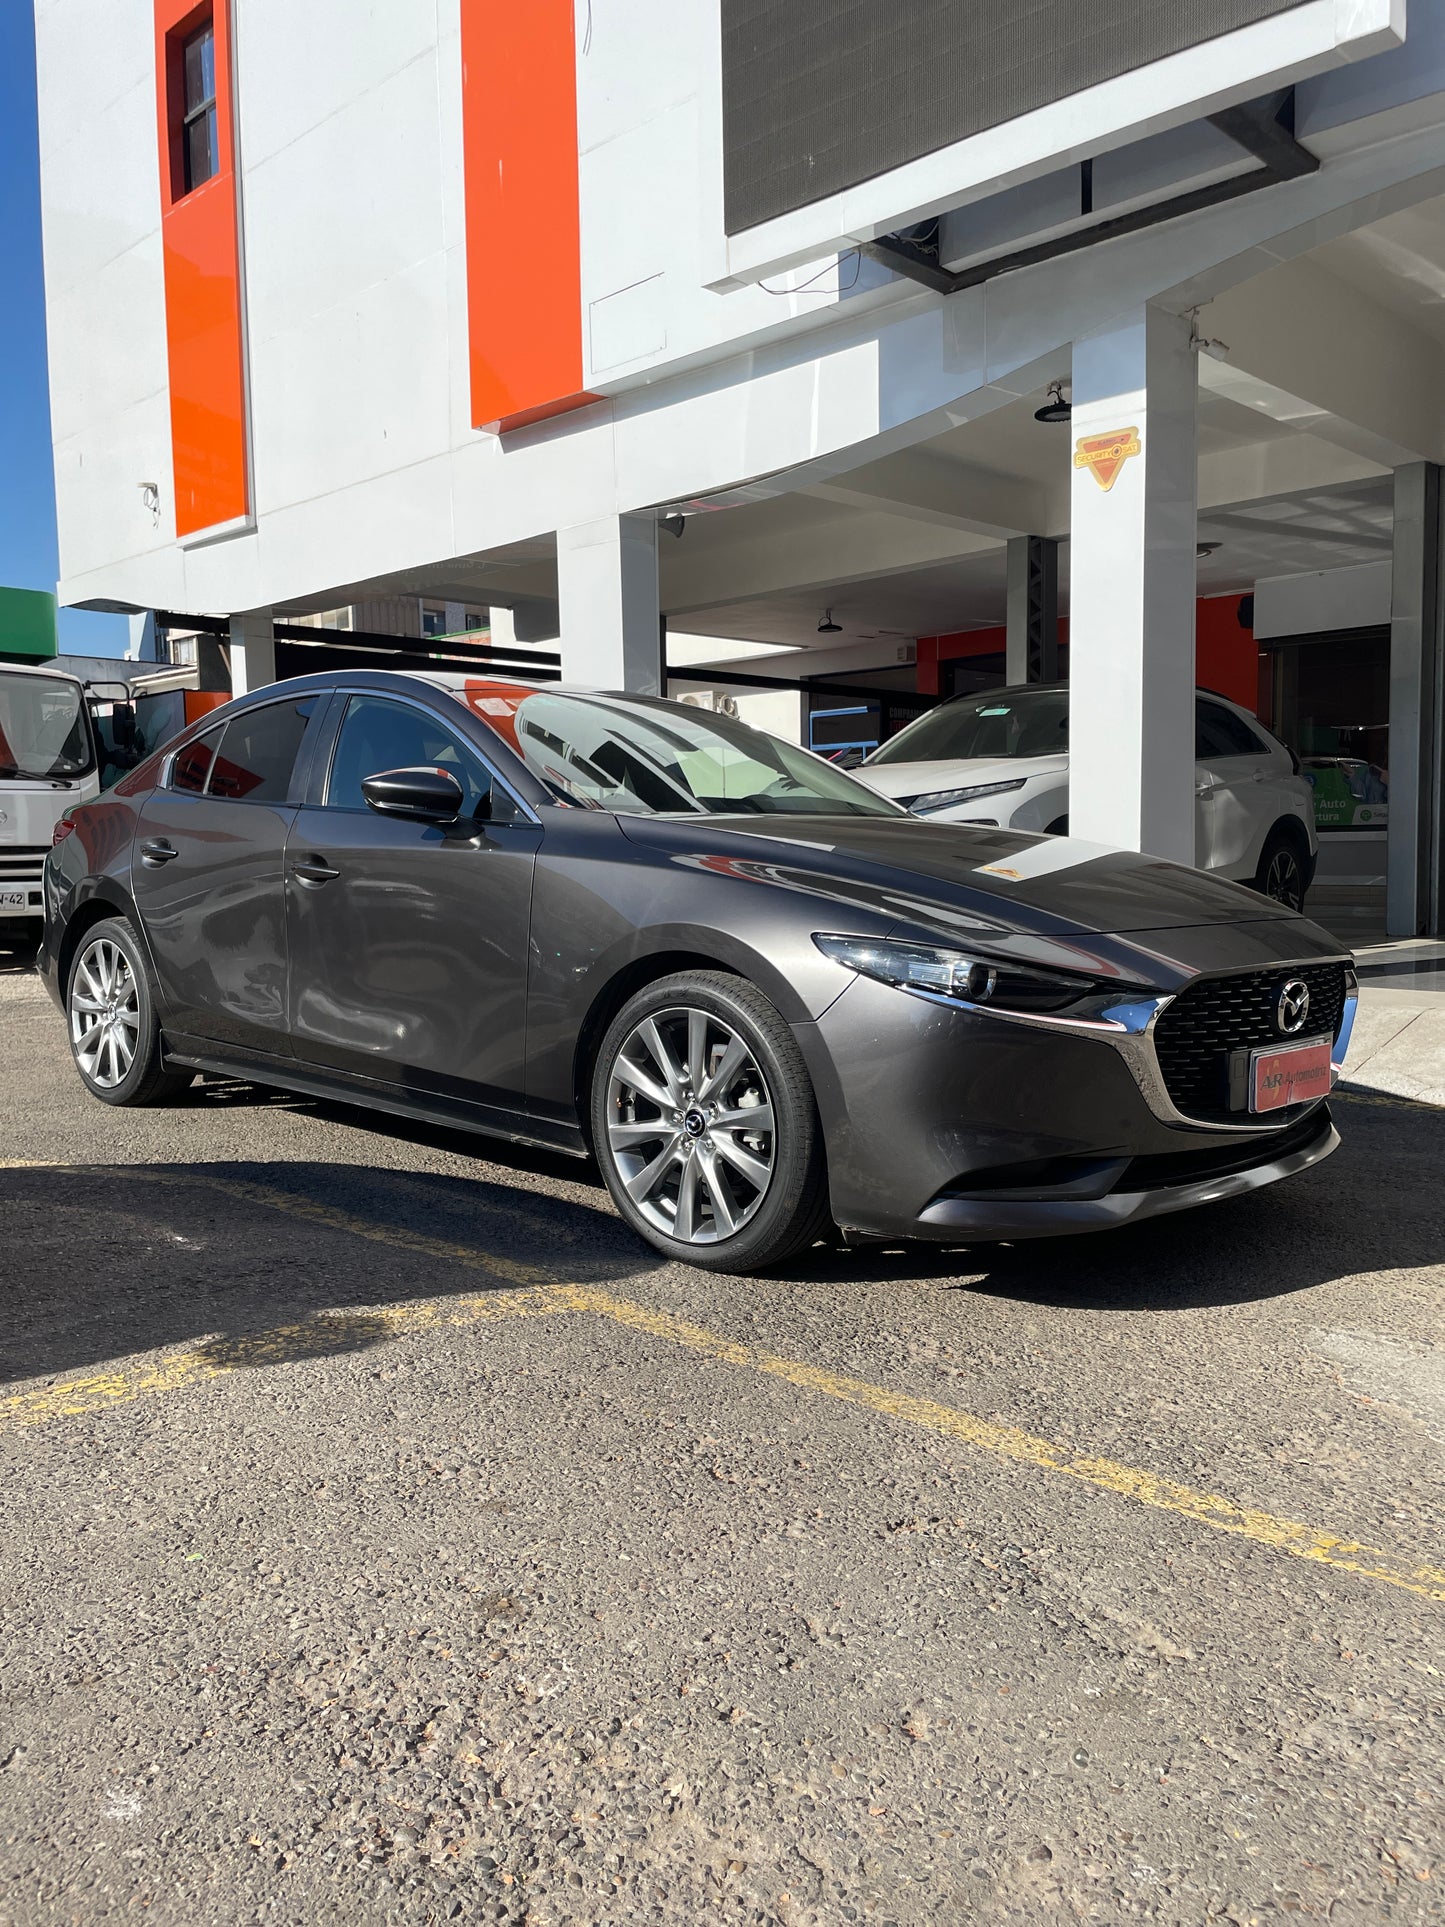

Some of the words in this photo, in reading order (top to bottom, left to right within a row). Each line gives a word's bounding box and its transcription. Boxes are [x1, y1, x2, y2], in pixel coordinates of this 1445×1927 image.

[1077, 451, 1112, 463] SECURITY
[1122, 445, 1137, 453] SAT
[1319, 799, 1346, 809] Auto
[1285, 1064, 1327, 1082] Automotriz
